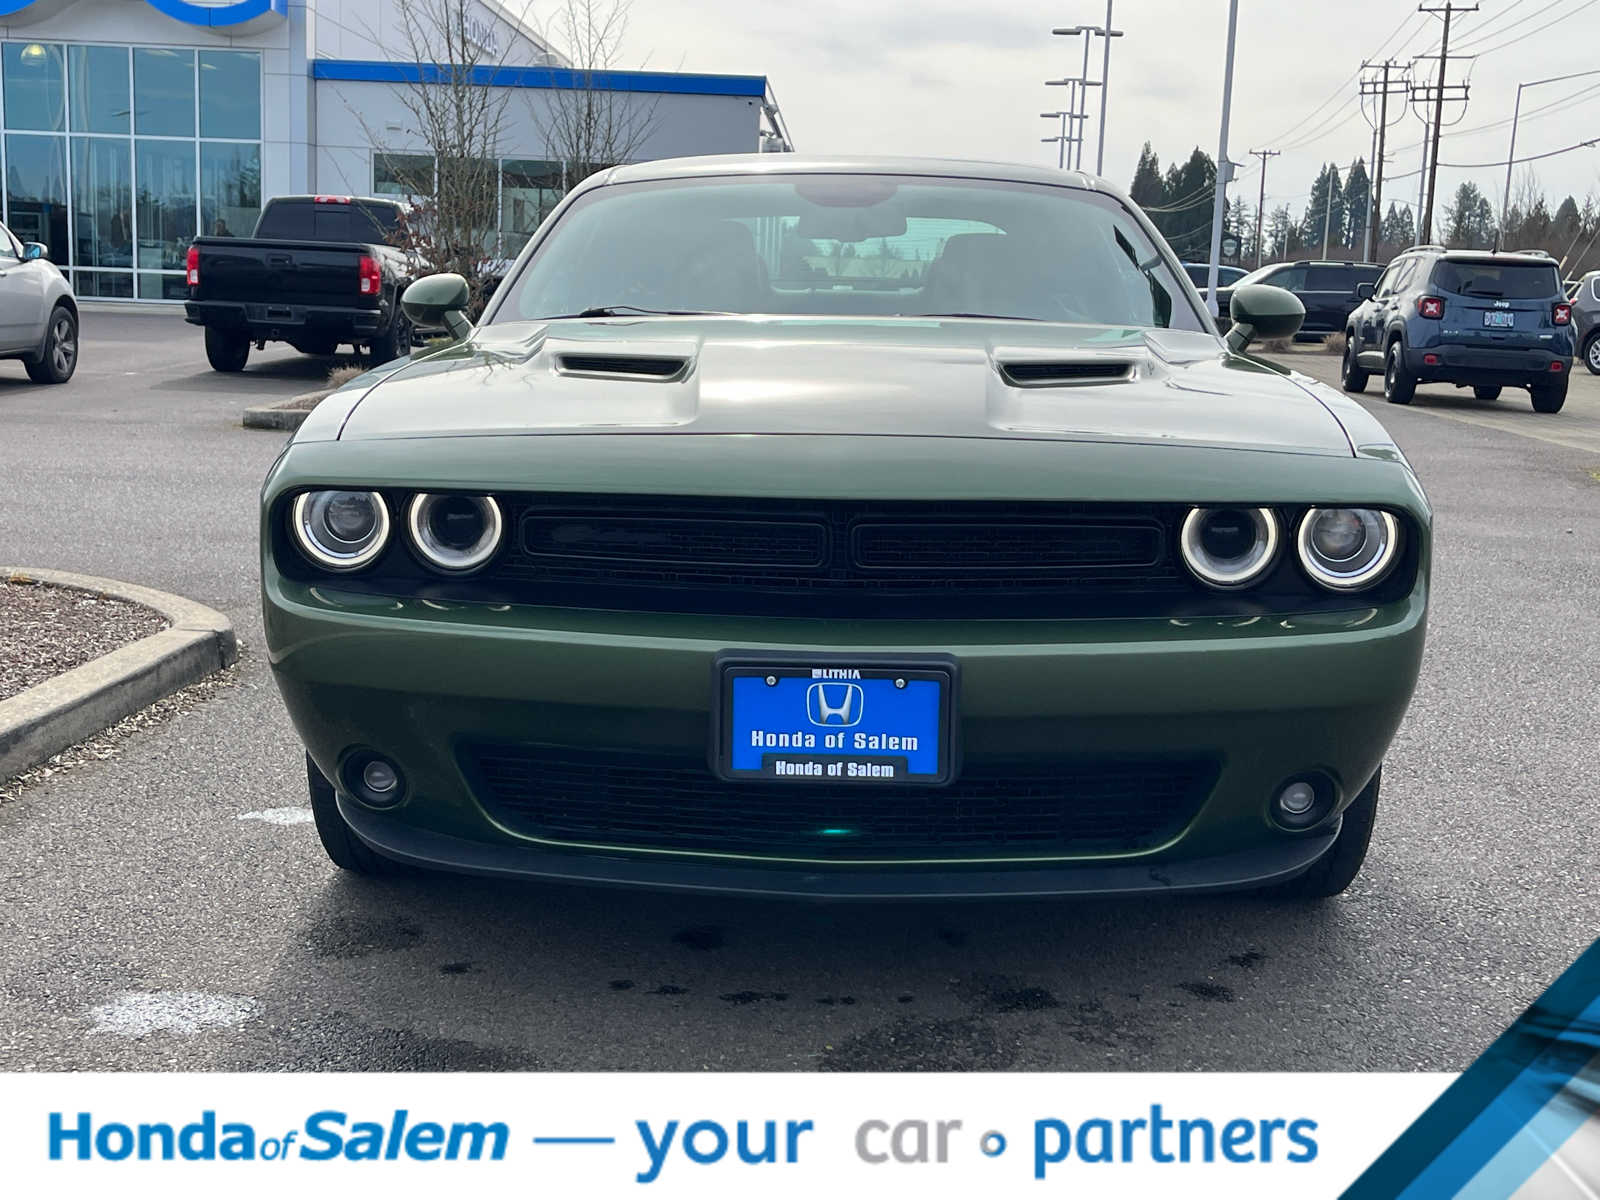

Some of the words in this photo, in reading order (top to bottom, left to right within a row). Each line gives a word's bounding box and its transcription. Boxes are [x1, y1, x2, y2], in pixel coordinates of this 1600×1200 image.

[822, 669, 861, 679] LITHIA
[751, 730, 816, 748] Honda
[824, 732, 846, 749] of
[853, 732, 919, 751] Salem
[775, 760, 823, 776] Honda
[827, 762, 843, 777] of
[847, 762, 894, 778] Salem
